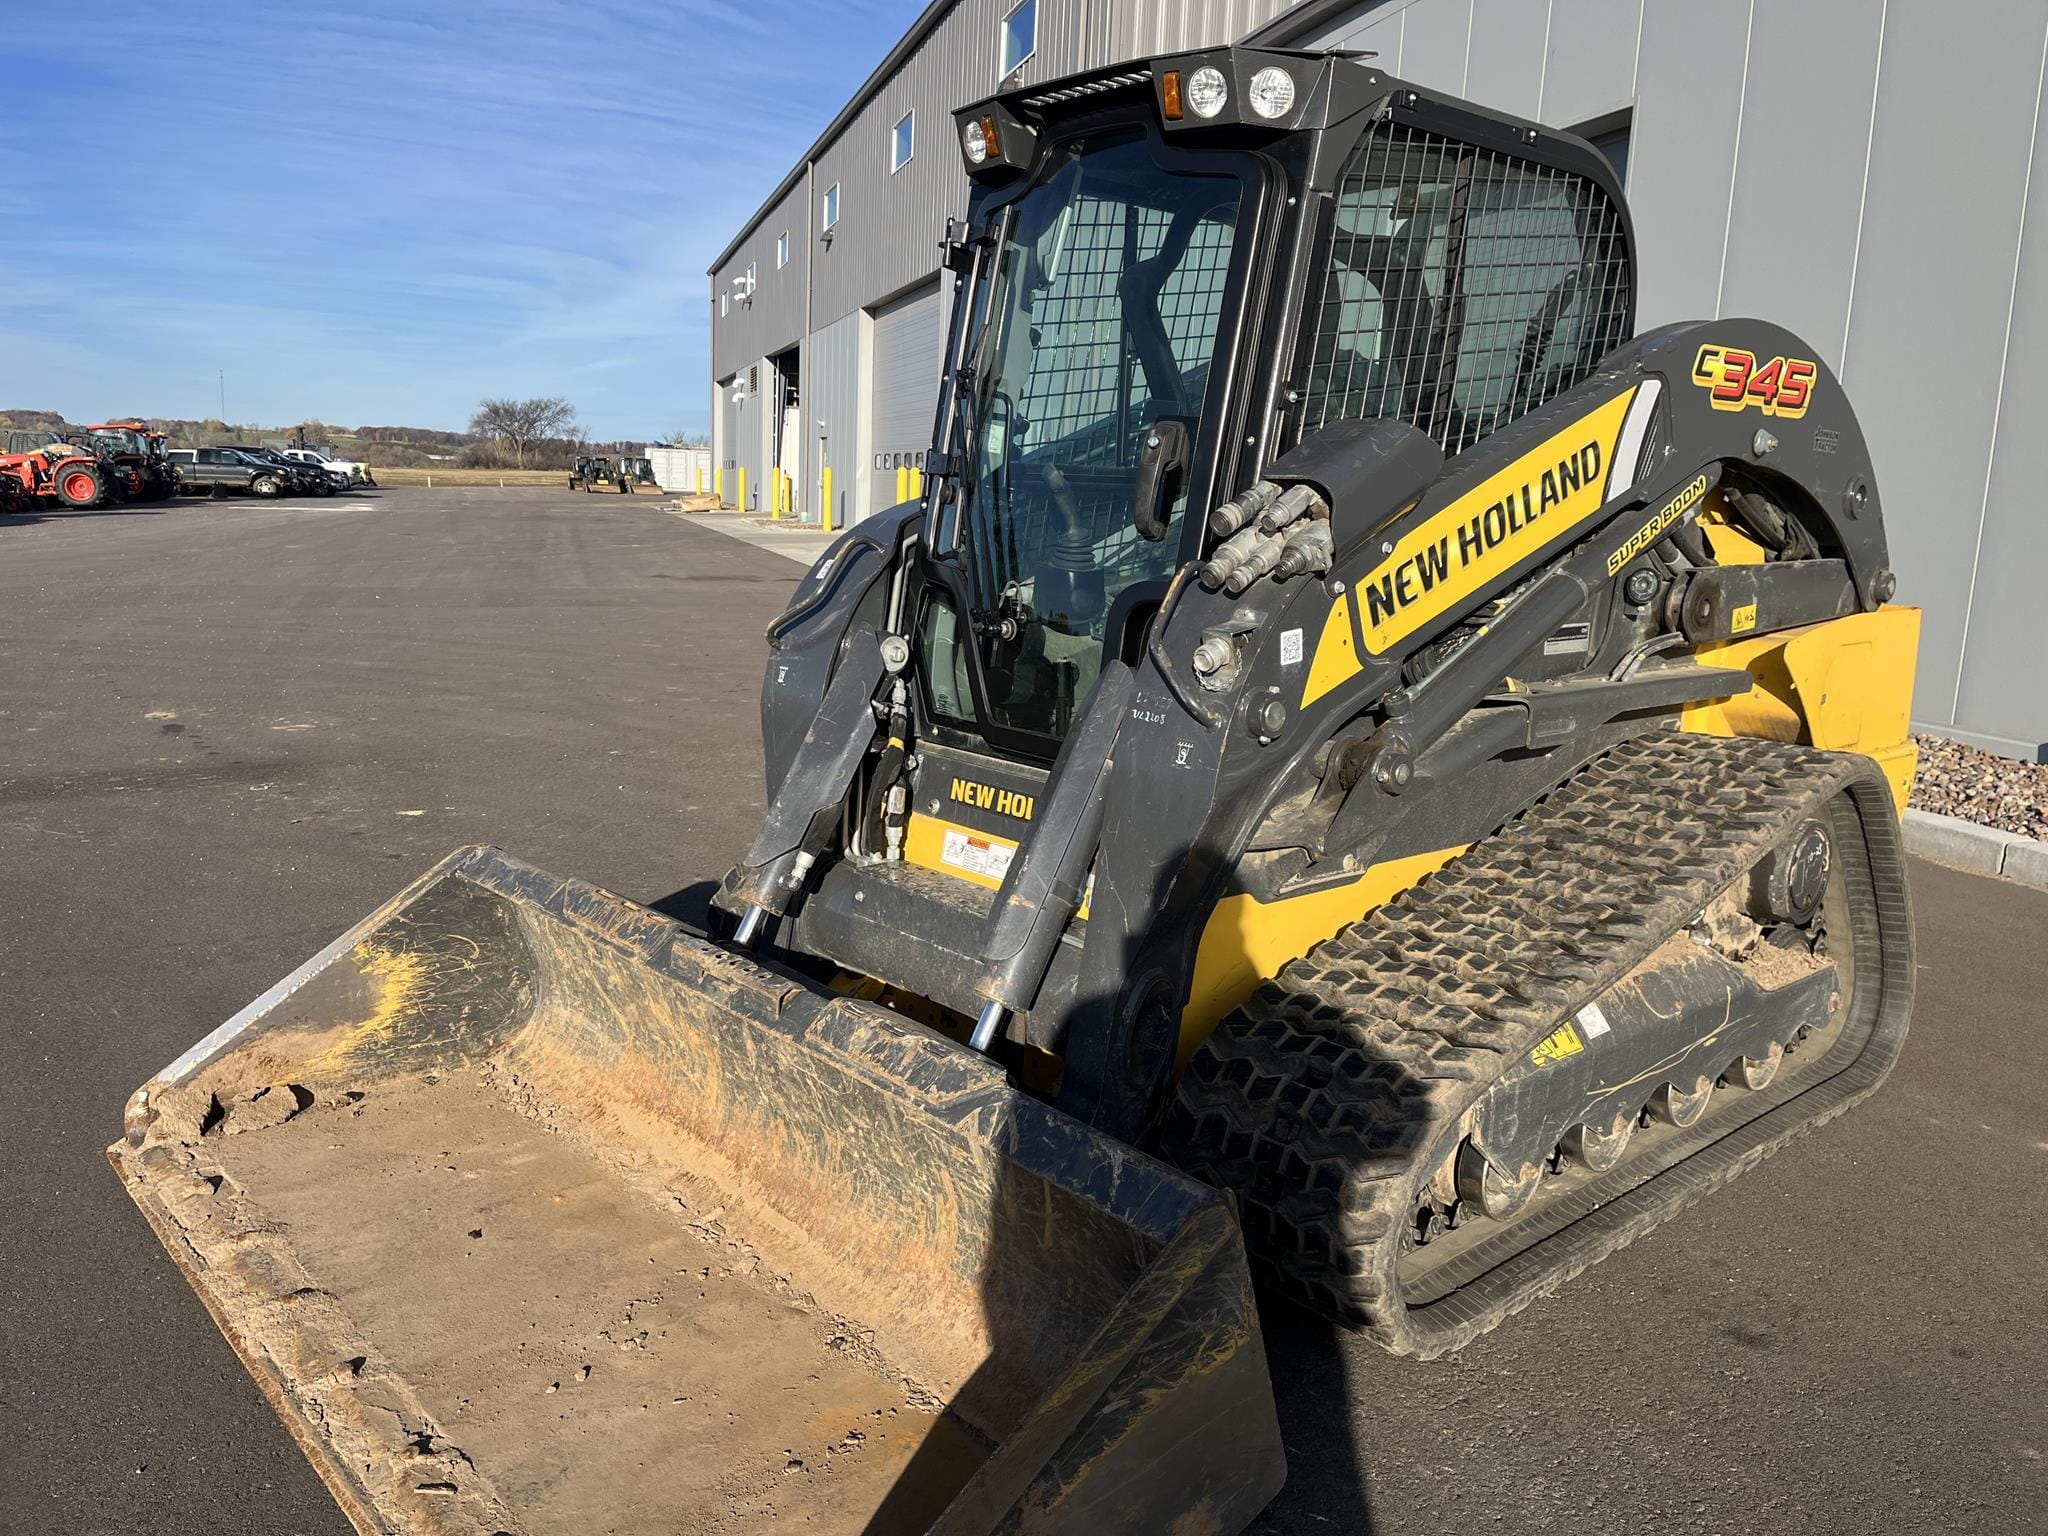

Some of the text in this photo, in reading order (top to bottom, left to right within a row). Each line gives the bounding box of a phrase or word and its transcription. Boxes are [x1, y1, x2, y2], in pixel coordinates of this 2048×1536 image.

[1693, 345, 1816, 416] C345
[1365, 439, 1601, 629] NEW HOLLAND
[1608, 475, 1706, 576] SUPER BOOM
[950, 777, 996, 809] NEW
